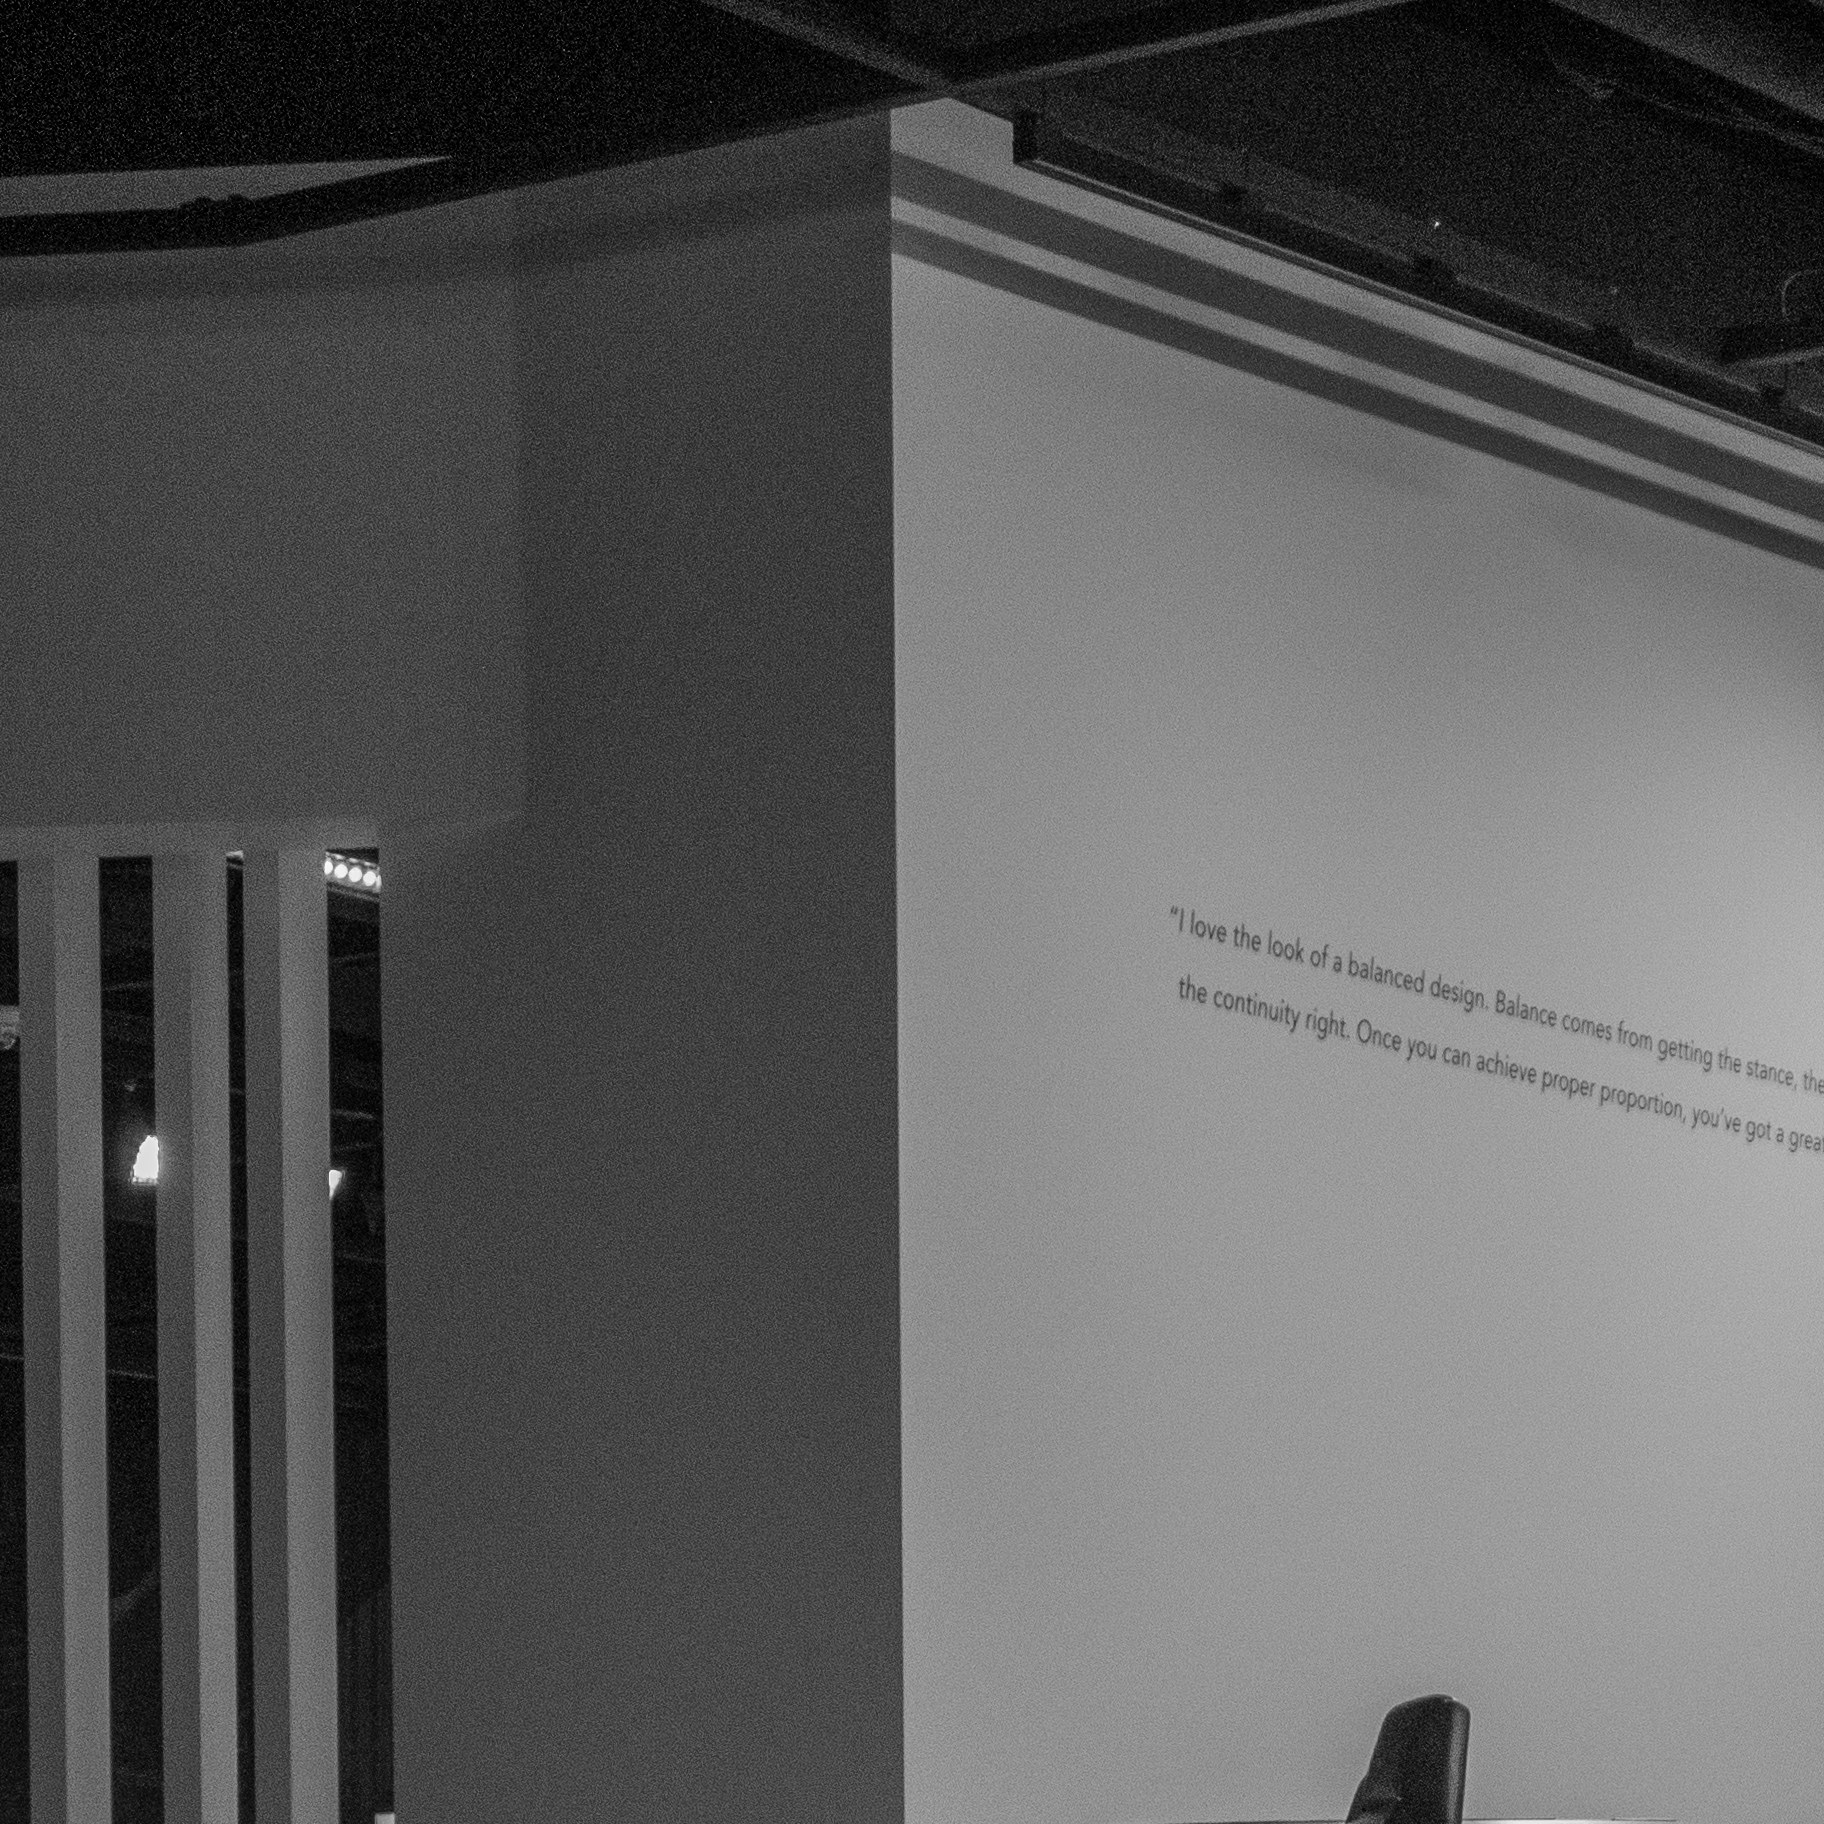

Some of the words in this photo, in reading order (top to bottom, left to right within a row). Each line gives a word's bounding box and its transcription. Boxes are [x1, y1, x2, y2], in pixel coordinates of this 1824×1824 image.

[1178, 975, 1208, 1004] the
[1213, 991, 1300, 1034] continuity
[1305, 1011, 1349, 1041] right.
[1356, 1019, 1402, 1052] Once
[1406, 1039, 1437, 1062] you
[1442, 1047, 1471, 1067] can
[1476, 1052, 1537, 1084] achieve
[1541, 1071, 1595, 1099] proper
[1599, 1085, 1686, 1123] proportion,
[1746, 1121, 1771, 1144] got
[1776, 1128, 1784, 1144] a
[1190, 910, 1227, 944] love
[1233, 924, 1262, 953] the
[1267, 930, 1304, 963] look
[1310, 944, 1329, 968] of
[1332, 956, 1342, 973] a
[1348, 952, 1425, 994] balanced
[1429, 975, 1491, 1014] design.
[1495, 990, 1557, 1028] Balance
[1562, 1014, 1612, 1042] comes
[1617, 1020, 1652, 1051] from
[1658, 1039, 1713, 1073] getting
[1718, 1049, 1742, 1074] the
[1746, 1060, 1798, 1090] stance,
